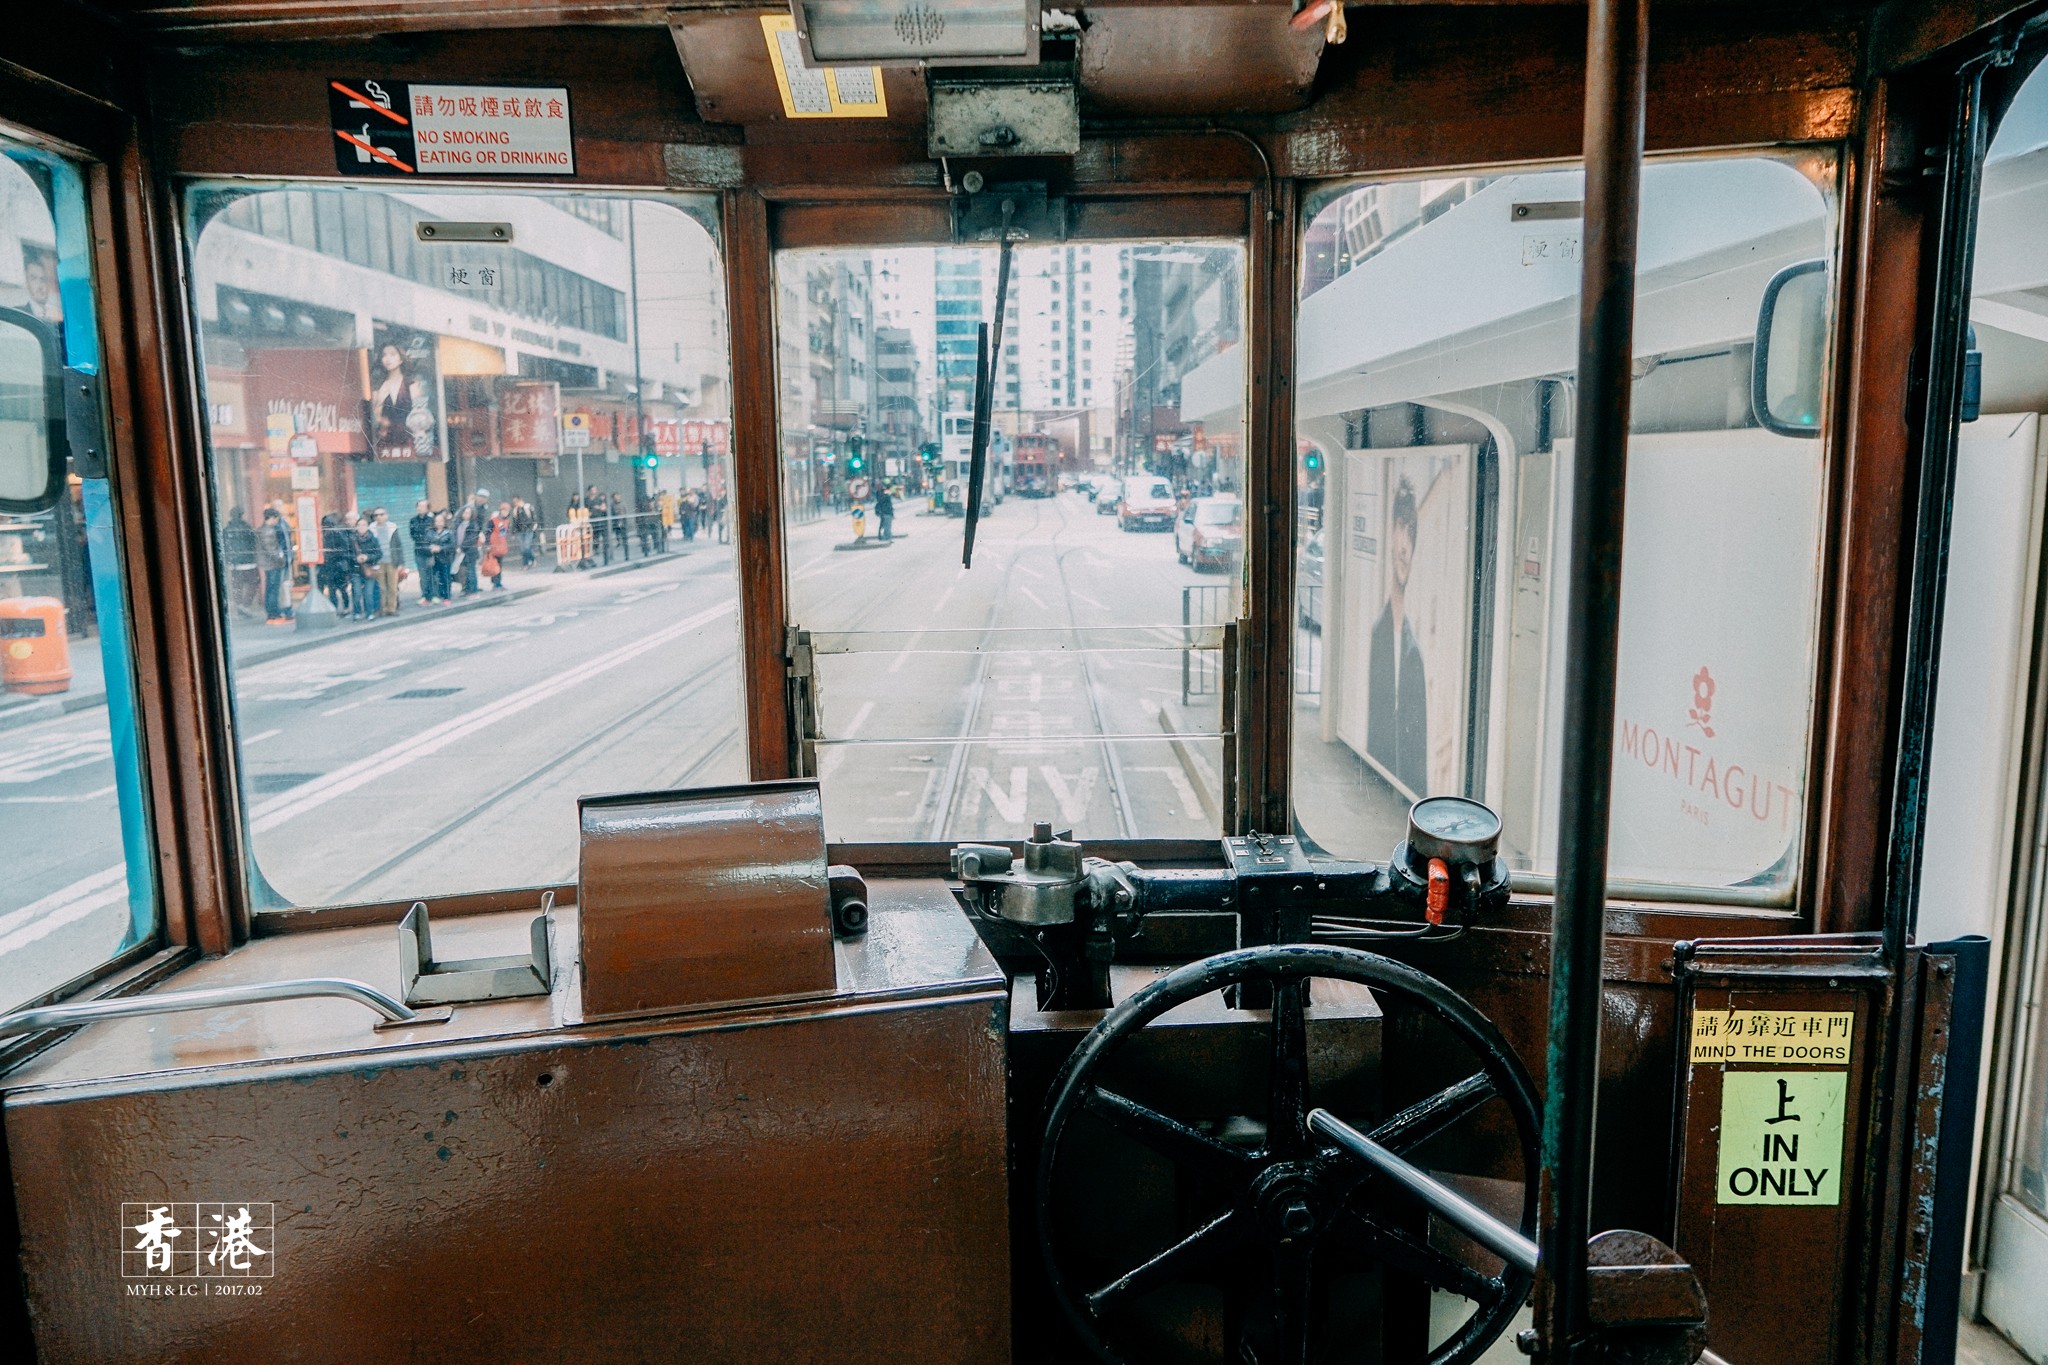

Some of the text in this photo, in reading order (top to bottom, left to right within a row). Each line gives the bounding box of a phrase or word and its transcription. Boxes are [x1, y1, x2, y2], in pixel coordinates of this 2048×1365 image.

[414, 95, 564, 119] 請勿吸煙或飲食
[417, 130, 510, 145] NO SMOKING
[419, 150, 568, 165] EATING OR DRINKING
[450, 265, 496, 287] 梗窗
[1622, 719, 1797, 833] MONTAGUT
[1696, 1015, 1849, 1038] 請勿靠近車門
[1694, 1045, 1846, 1059] MIND THE DOORS
[1764, 1078, 1801, 1125] 上
[1762, 1133, 1799, 1162] IN
[1729, 1167, 1829, 1197] ONLY
